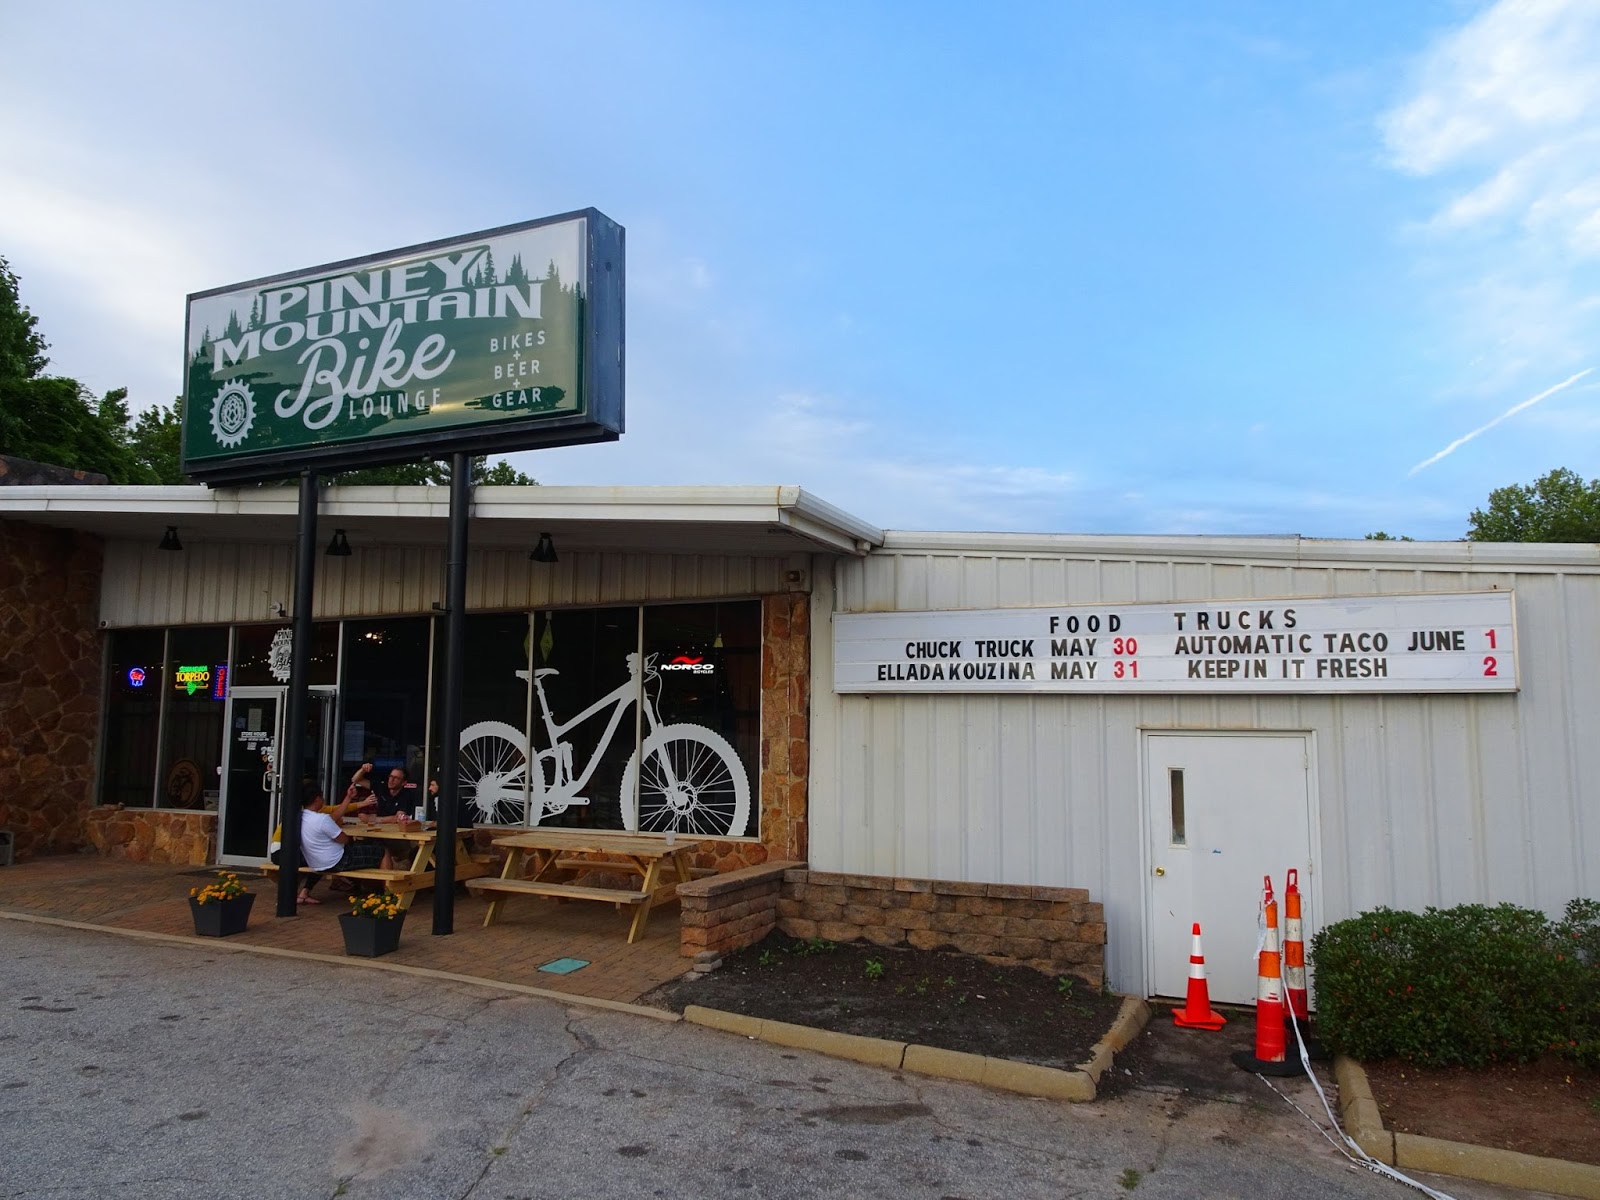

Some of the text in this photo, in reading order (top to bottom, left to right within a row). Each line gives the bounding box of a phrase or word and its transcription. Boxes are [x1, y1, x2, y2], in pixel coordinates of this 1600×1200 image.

[262, 249, 484, 326] PINEY
[212, 282, 544, 375] MOUNTAIN
[490, 330, 546, 353] BIKES
[274, 317, 456, 430] Bike
[494, 359, 541, 380] BEER
[349, 387, 441, 420] LOUNGE
[492, 387, 542, 408] GEAR
[1050, 608, 1297, 634] FOOD TRUCKS
[905, 637, 1138, 659] CHUCK TRUCK MAY 30
[1174, 628, 1498, 655] AUTOMATIC TACO JUNE 1
[175, 672, 210, 682] TORPEDO
[1050, 660, 1098, 680] MAY
[1112, 660, 1139, 679] 31
[1187, 657, 1388, 679] KEEPIN IT FRESH
[1483, 656, 1498, 677] 2
[216, 668, 226, 698] OPEN
